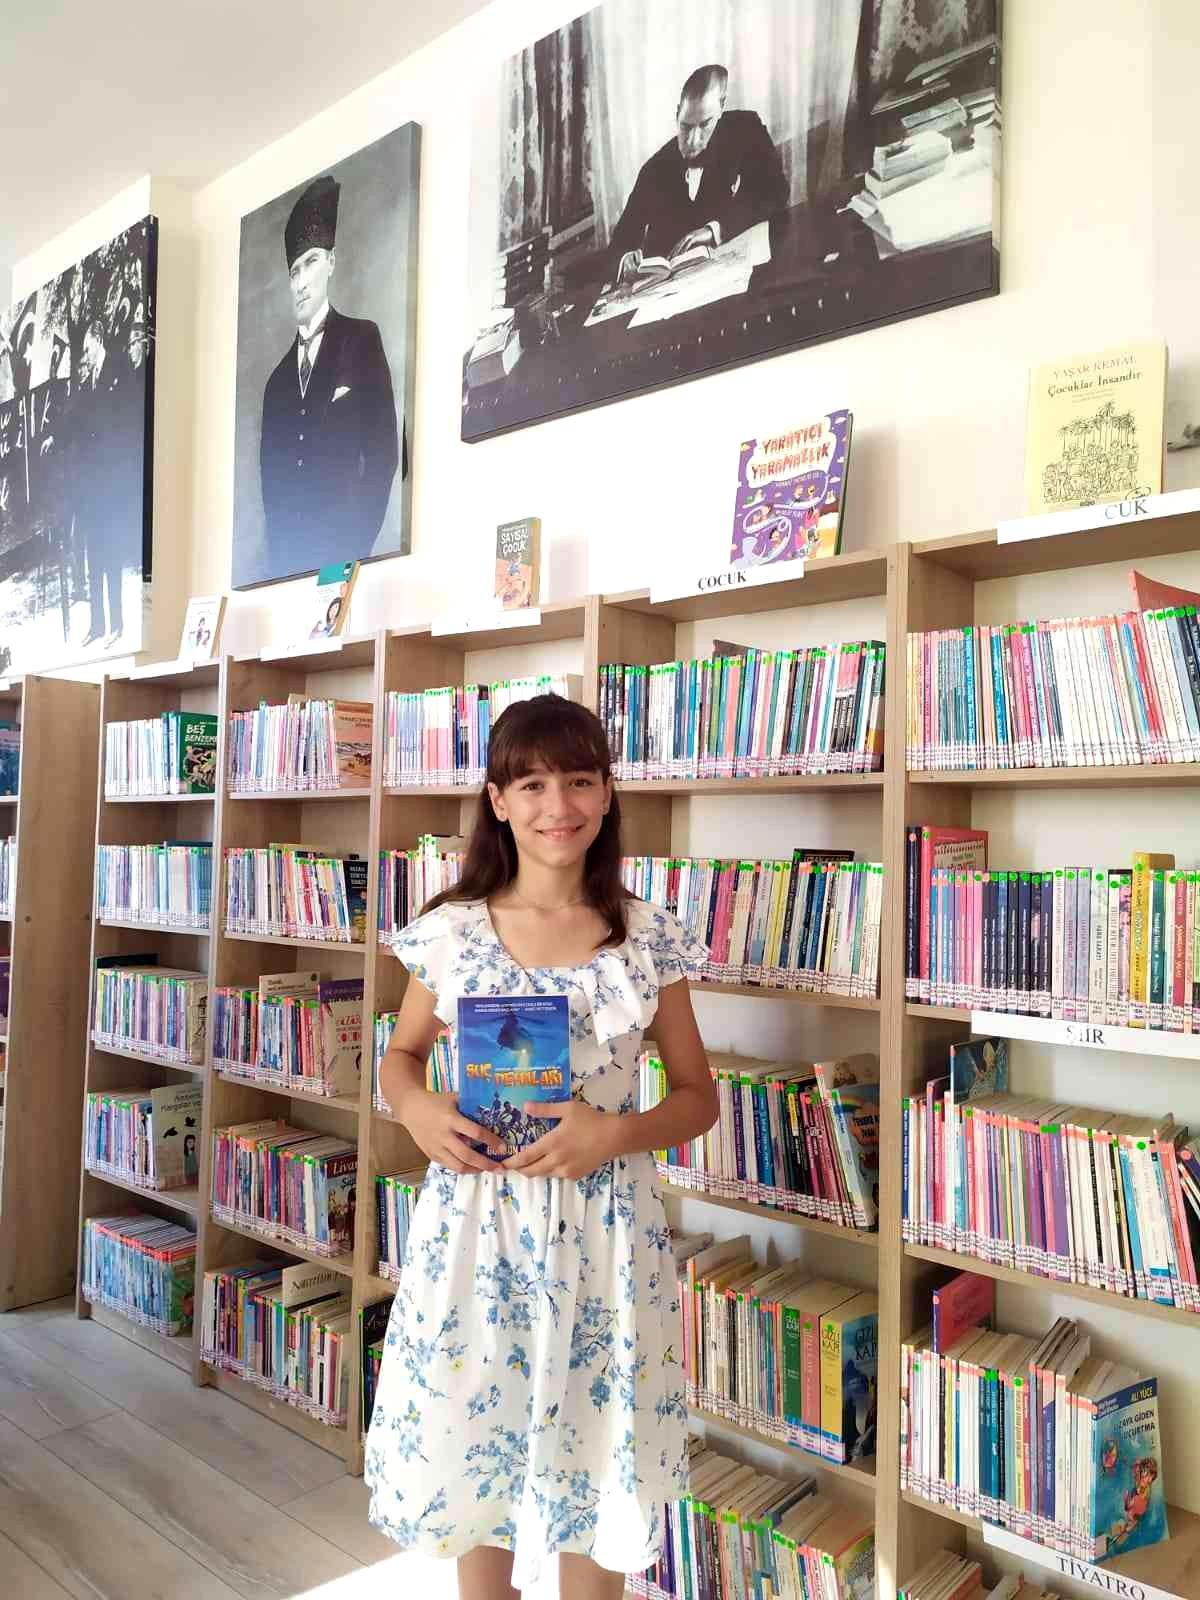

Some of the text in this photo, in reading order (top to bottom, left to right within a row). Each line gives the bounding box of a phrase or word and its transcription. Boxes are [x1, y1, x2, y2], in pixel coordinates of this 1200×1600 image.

[1047, 379, 1094, 398] Çocuklar
[697, 569, 747, 592] ÇOCUK
[1055, 1554, 1146, 1600] TİYATRO
